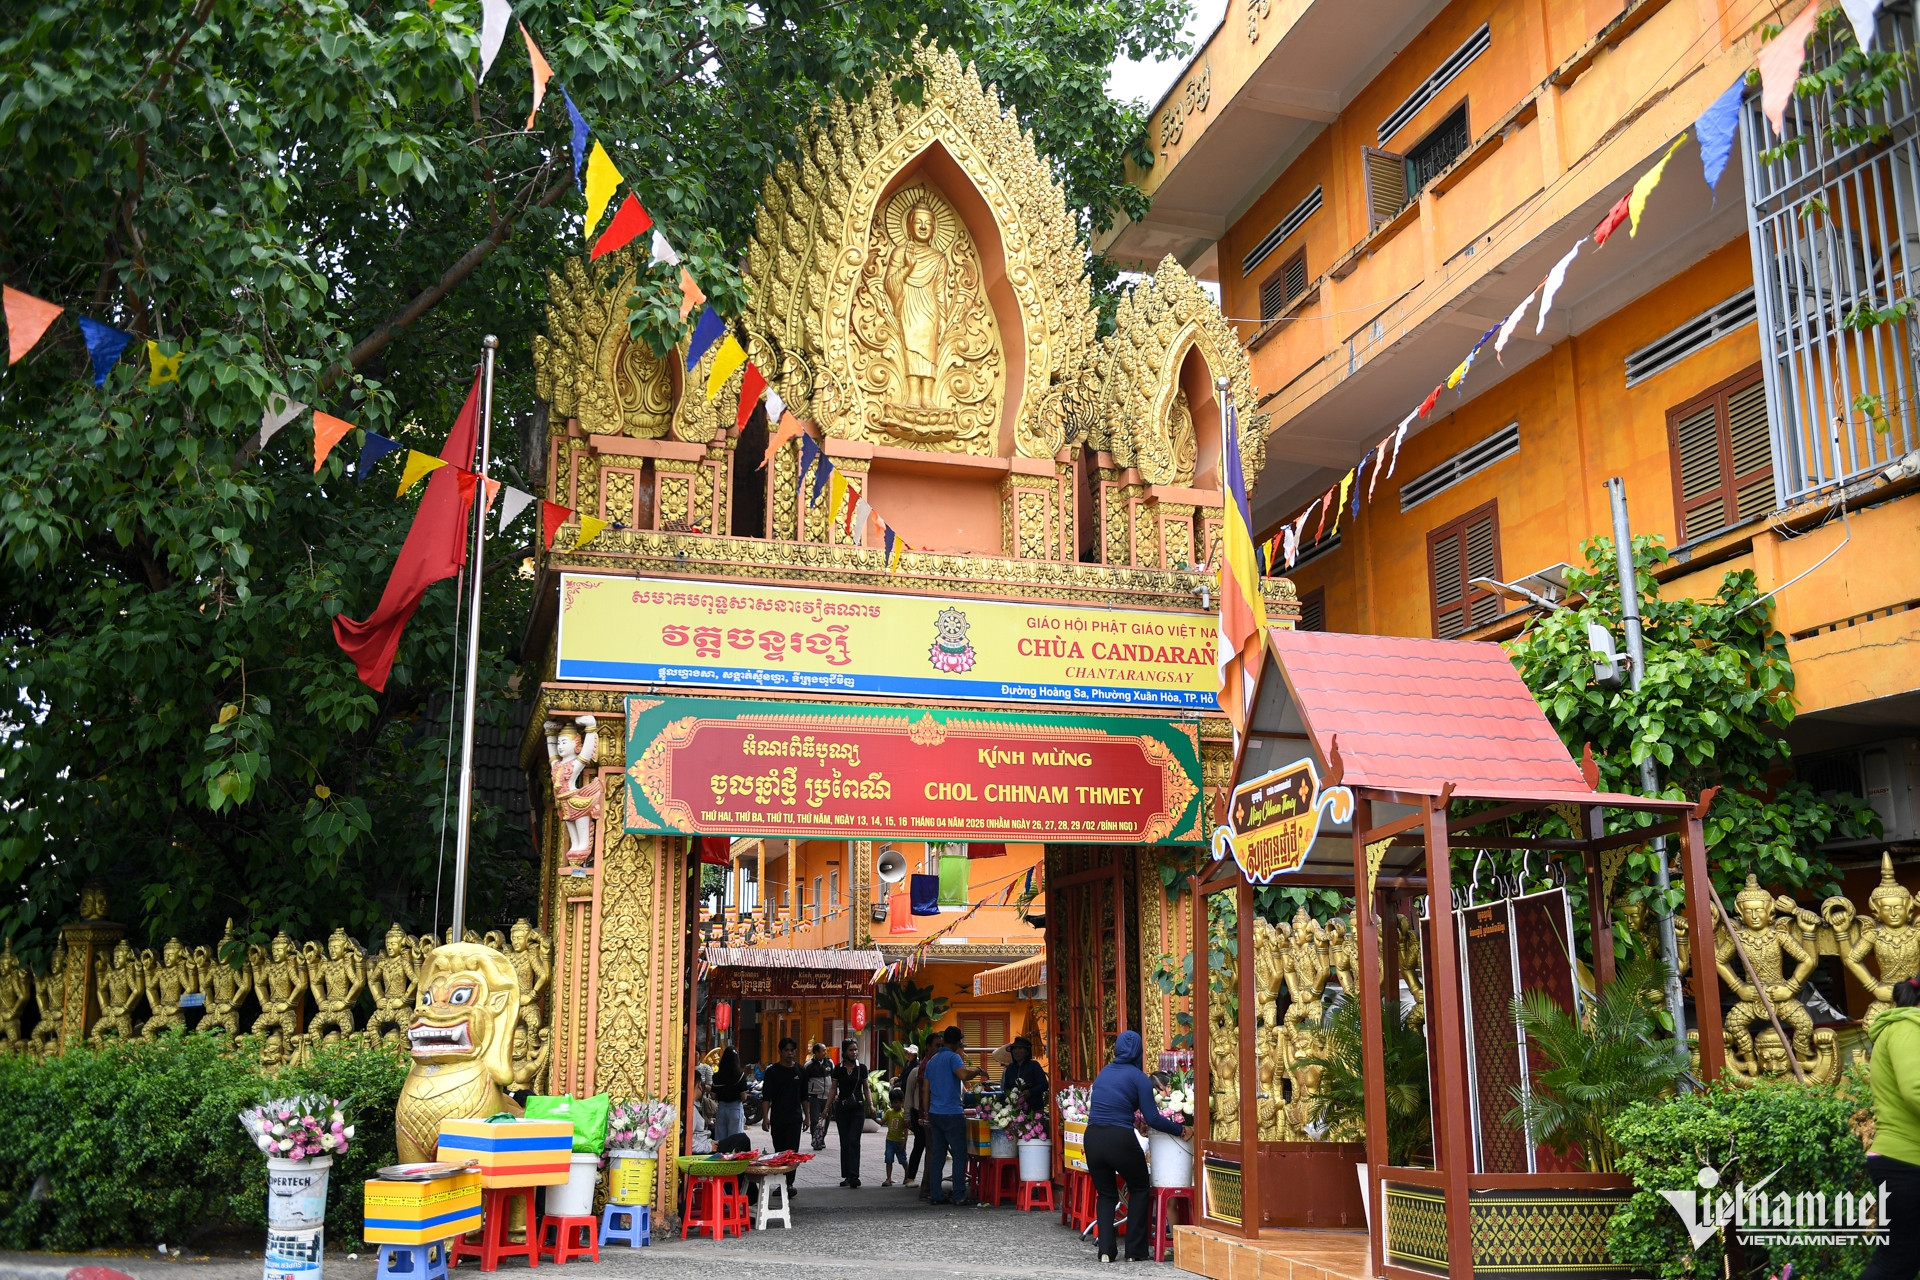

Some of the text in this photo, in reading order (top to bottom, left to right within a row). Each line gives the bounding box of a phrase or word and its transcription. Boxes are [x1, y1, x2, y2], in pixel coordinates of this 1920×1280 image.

[1027, 616, 1218, 639] GIÁO HỘI PHẬT GIÁO VIỆT NA
[1018, 635, 1084, 658] CHÙA
[1065, 666, 1194, 683] CHANTARANGSAY
[1001, 685, 1214, 704] Đường Hoàng Sa, Phường Xuân Hòa, TP. Hồ
[978, 745, 1093, 768] KÍNH MỪNG
[925, 782, 1143, 805] CHOL CHHNAM THMEY
[701, 810, 717, 821] THỨ
[718, 811, 733, 822] HAI,
[735, 811, 750, 822] THỨ
[752, 812, 765, 823] BA,
[766, 812, 782, 823] THỨ
[797, 813, 812, 823] THỨ
[814, 813, 832, 825] NĂM,
[835, 814, 854, 824] NGÀY
[857, 816, 868, 825] 13,
[871, 816, 882, 826] 14,
[885, 817, 895, 826] 15,
[899, 817, 907, 826] 16
[911, 816, 935, 826] THÁNG
[937, 818, 946, 827] 04
[948, 817, 964, 827] NĂM
[966, 819, 984, 828] 2026
[1012, 818, 1030, 829] NGÀY
[1032, 820, 1043, 830] 26,
[1045, 821, 1056, 830] 27,
[1058, 821, 1069, 830] 28,
[1071, 821, 1080, 829] 29
